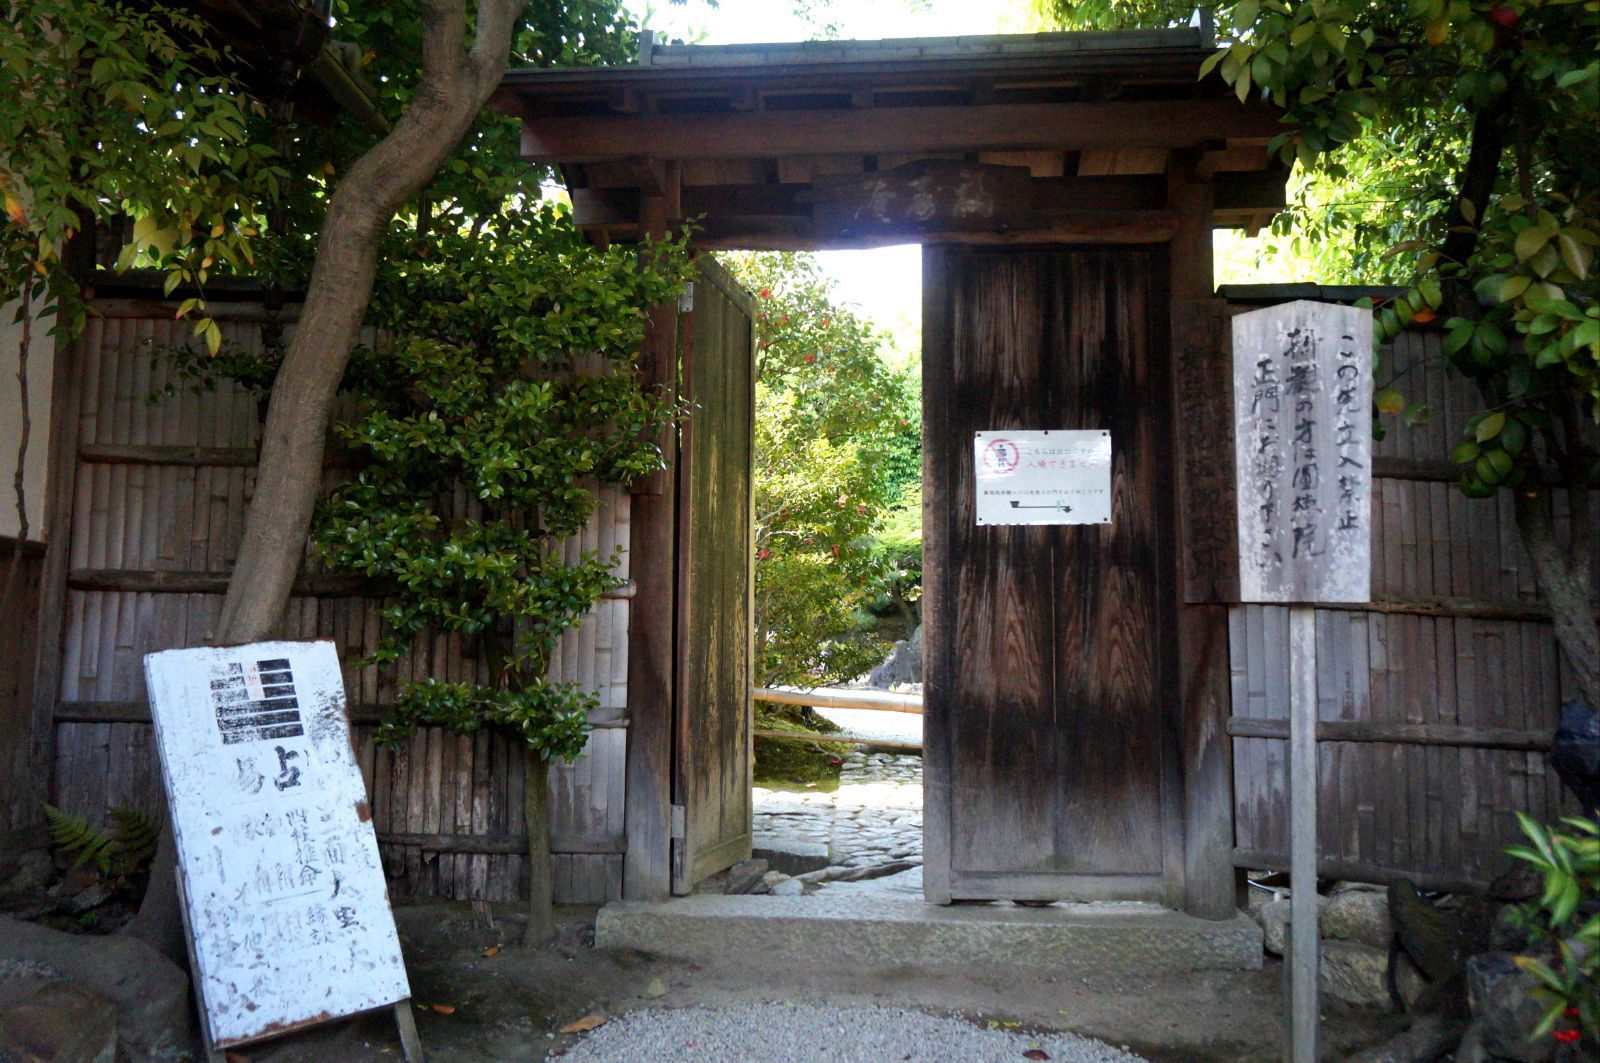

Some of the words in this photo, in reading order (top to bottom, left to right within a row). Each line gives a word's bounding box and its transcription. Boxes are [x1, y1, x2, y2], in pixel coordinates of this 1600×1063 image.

[1027, 459, 1098, 469] 入場できません
[1336, 334, 1364, 532] この先立入禁止
[286, 807, 322, 887] 四柱推命
